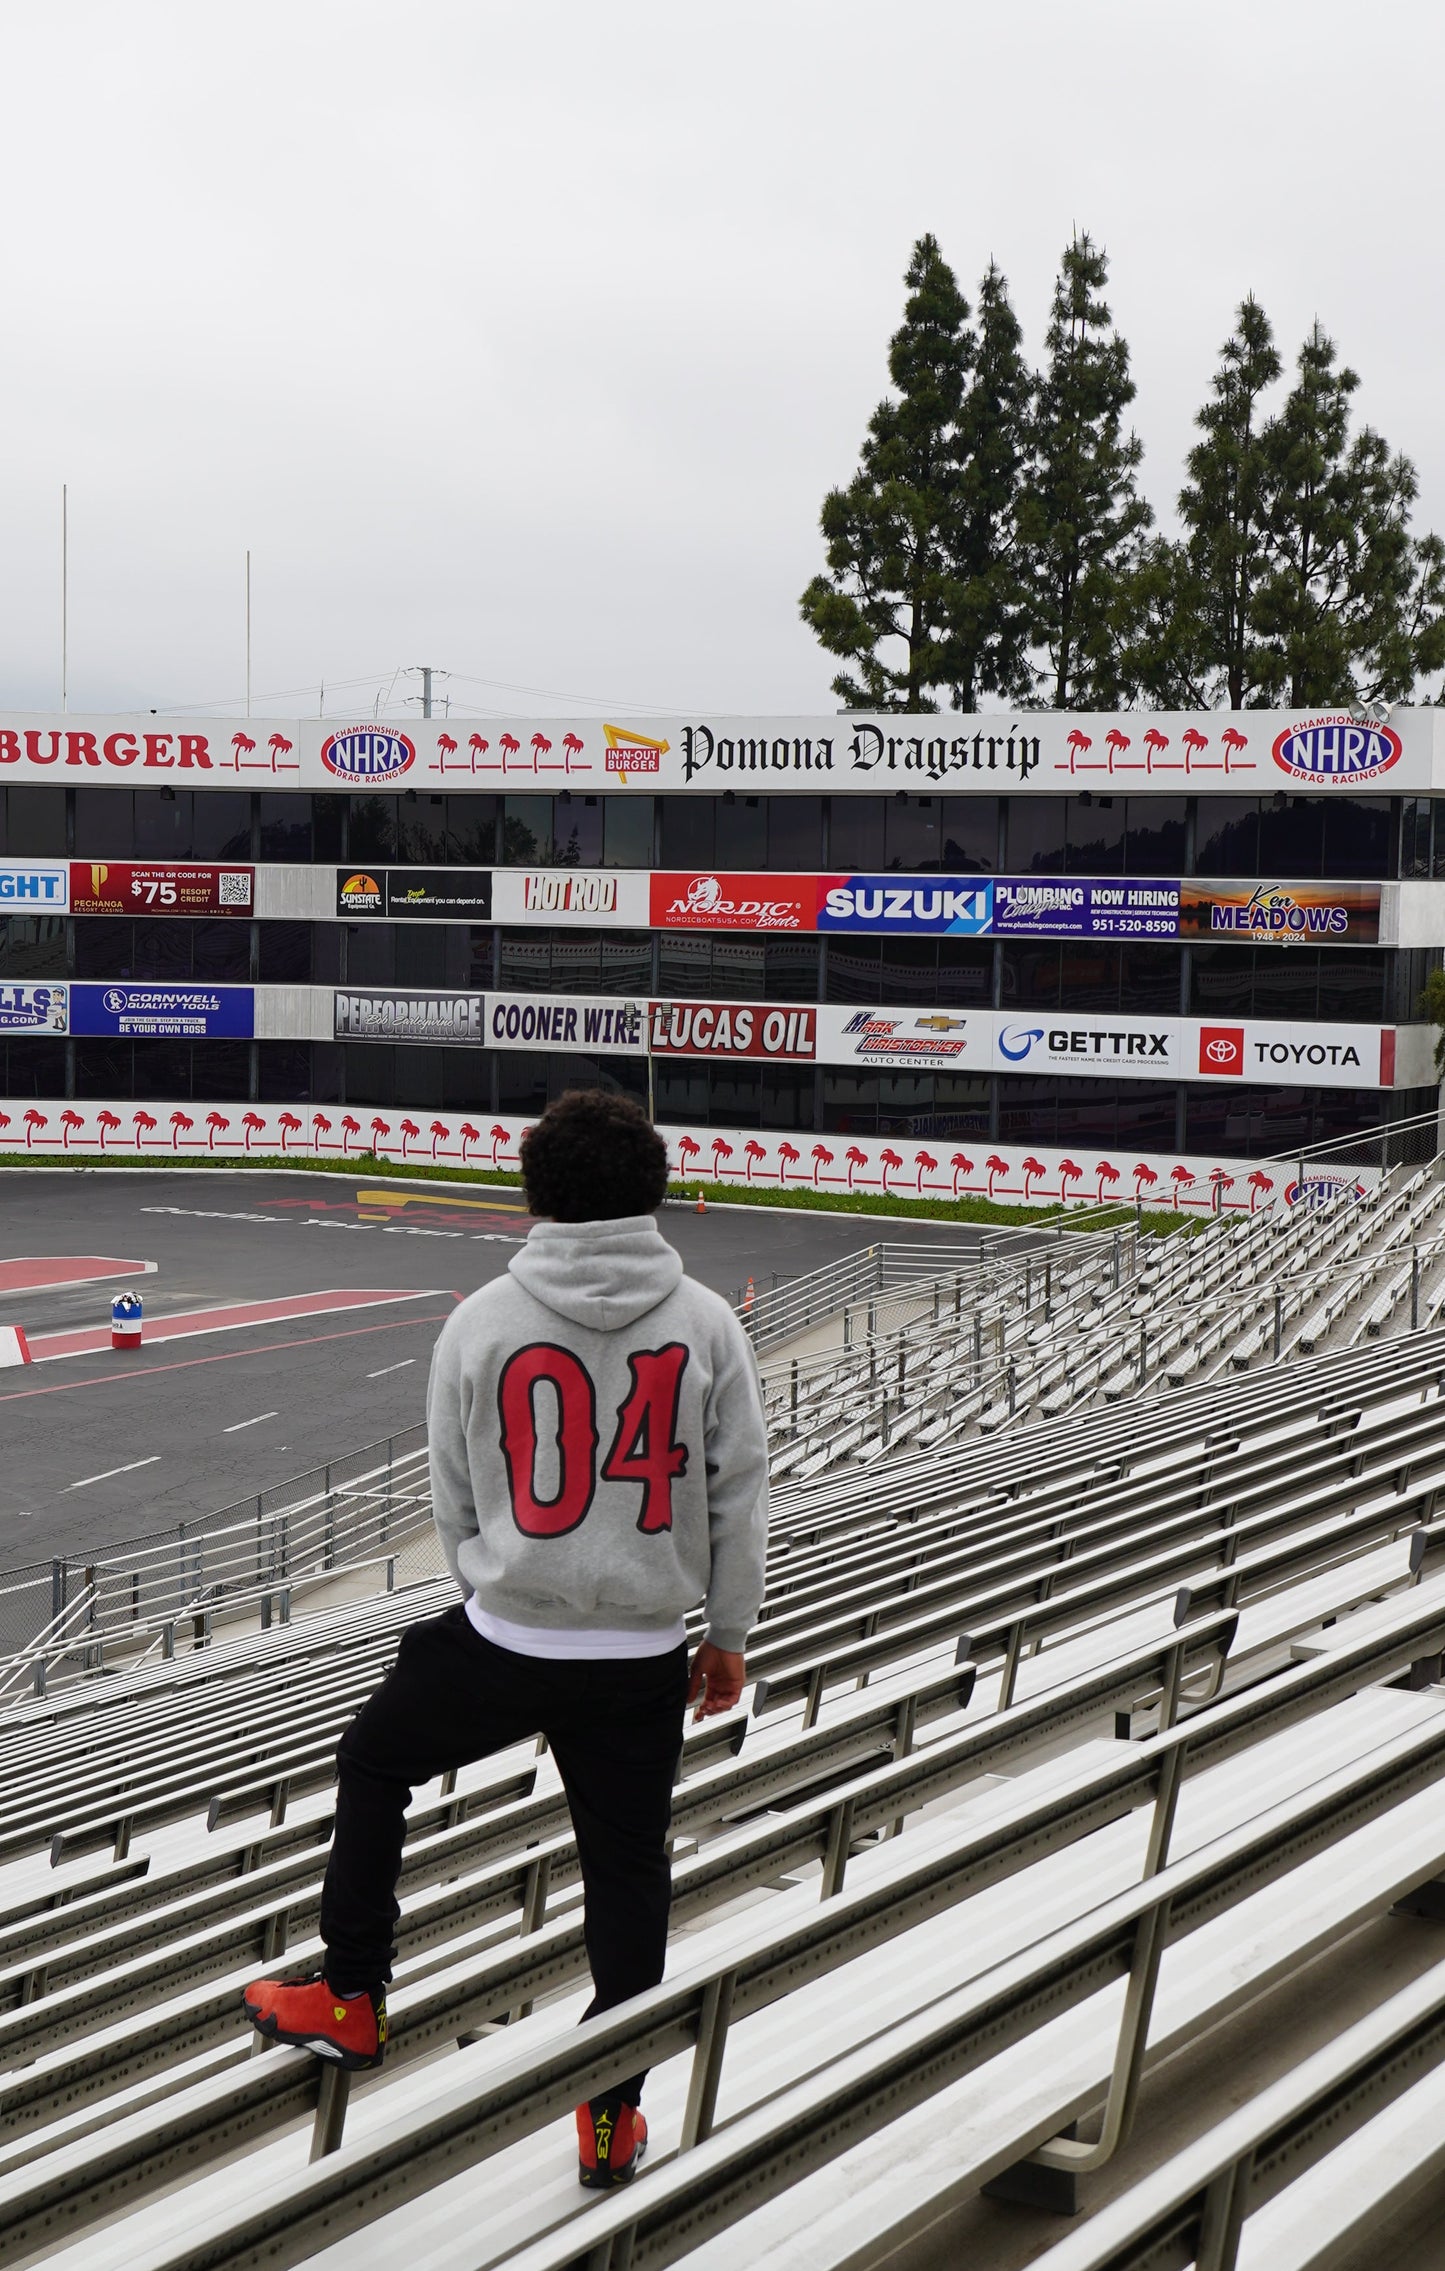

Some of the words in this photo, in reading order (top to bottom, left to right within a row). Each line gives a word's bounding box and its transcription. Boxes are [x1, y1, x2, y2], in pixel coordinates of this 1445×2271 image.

[335, 725, 400, 739] CHAMPIONSHIP
[1292, 716, 1381, 733] CHAMPIONSHIP
[0, 730, 214, 768] BURGER
[336, 735, 403, 772] NHRA
[680, 725, 836, 784] Pomona
[847, 723, 1041, 781] Dragstrip
[1292, 728, 1384, 772] NHRA
[608, 760, 656, 770] BURGER
[337, 769, 360, 783] DRAG
[365, 769, 399, 783] RACING
[1292, 769, 1325, 784] DRAG
[1332, 769, 1377, 784] RACING
[131, 880, 177, 904] $75
[340, 893, 382, 905] SUNSTATE
[527, 876, 572, 911] HOT
[570, 876, 616, 912] ROD
[995, 886, 1084, 905] PLUMBING
[1090, 889, 1125, 905] NOW
[1127, 890, 1179, 906] HIRING
[1246, 885, 1293, 911] Ken
[74, 900, 123, 908] PECHANGA
[666, 900, 794, 916] NORDIC
[825, 888, 986, 920] SUZUKI
[1002, 897, 1063, 920] Concepts
[756, 914, 800, 928] Boats
[997, 922, 1083, 931] www.plumbingconcepts.com
[1092, 919, 1176, 933] 951-520-8590
[1211, 905, 1348, 933] MEADOWS
[1251, 932, 1274, 941] 1948
[1282, 933, 1306, 942] 2024
[127, 1002, 177, 1010] QUALITY
[182, 1003, 220, 1011] TOOLS
[128, 993, 219, 1004] CORNWELL
[336, 994, 481, 1036] PERFORMANCE
[365, 1014, 389, 1025] Bob
[493, 1004, 577, 1042] COONER
[584, 1008, 642, 1044] WIRE
[119, 1024, 131, 1033] BE
[133, 1024, 157, 1033] YOUR
[158, 1025, 181, 1034] OWN
[183, 1025, 207, 1034] BOSS
[652, 1007, 754, 1050] LUCAS
[763, 1011, 814, 1052] OIL
[1048, 1030, 1169, 1056] GETTRX
[861, 1056, 894, 1065] AUTO
[899, 1058, 944, 1066] CENTER
[1254, 1043, 1360, 1066] TOYOTA
[140, 1206, 294, 1222] Quality
[298, 1218, 377, 1230] You
[382, 1226, 465, 1238] Can
[497, 1341, 690, 1540] 04
[596, 2128, 611, 2159] 23
